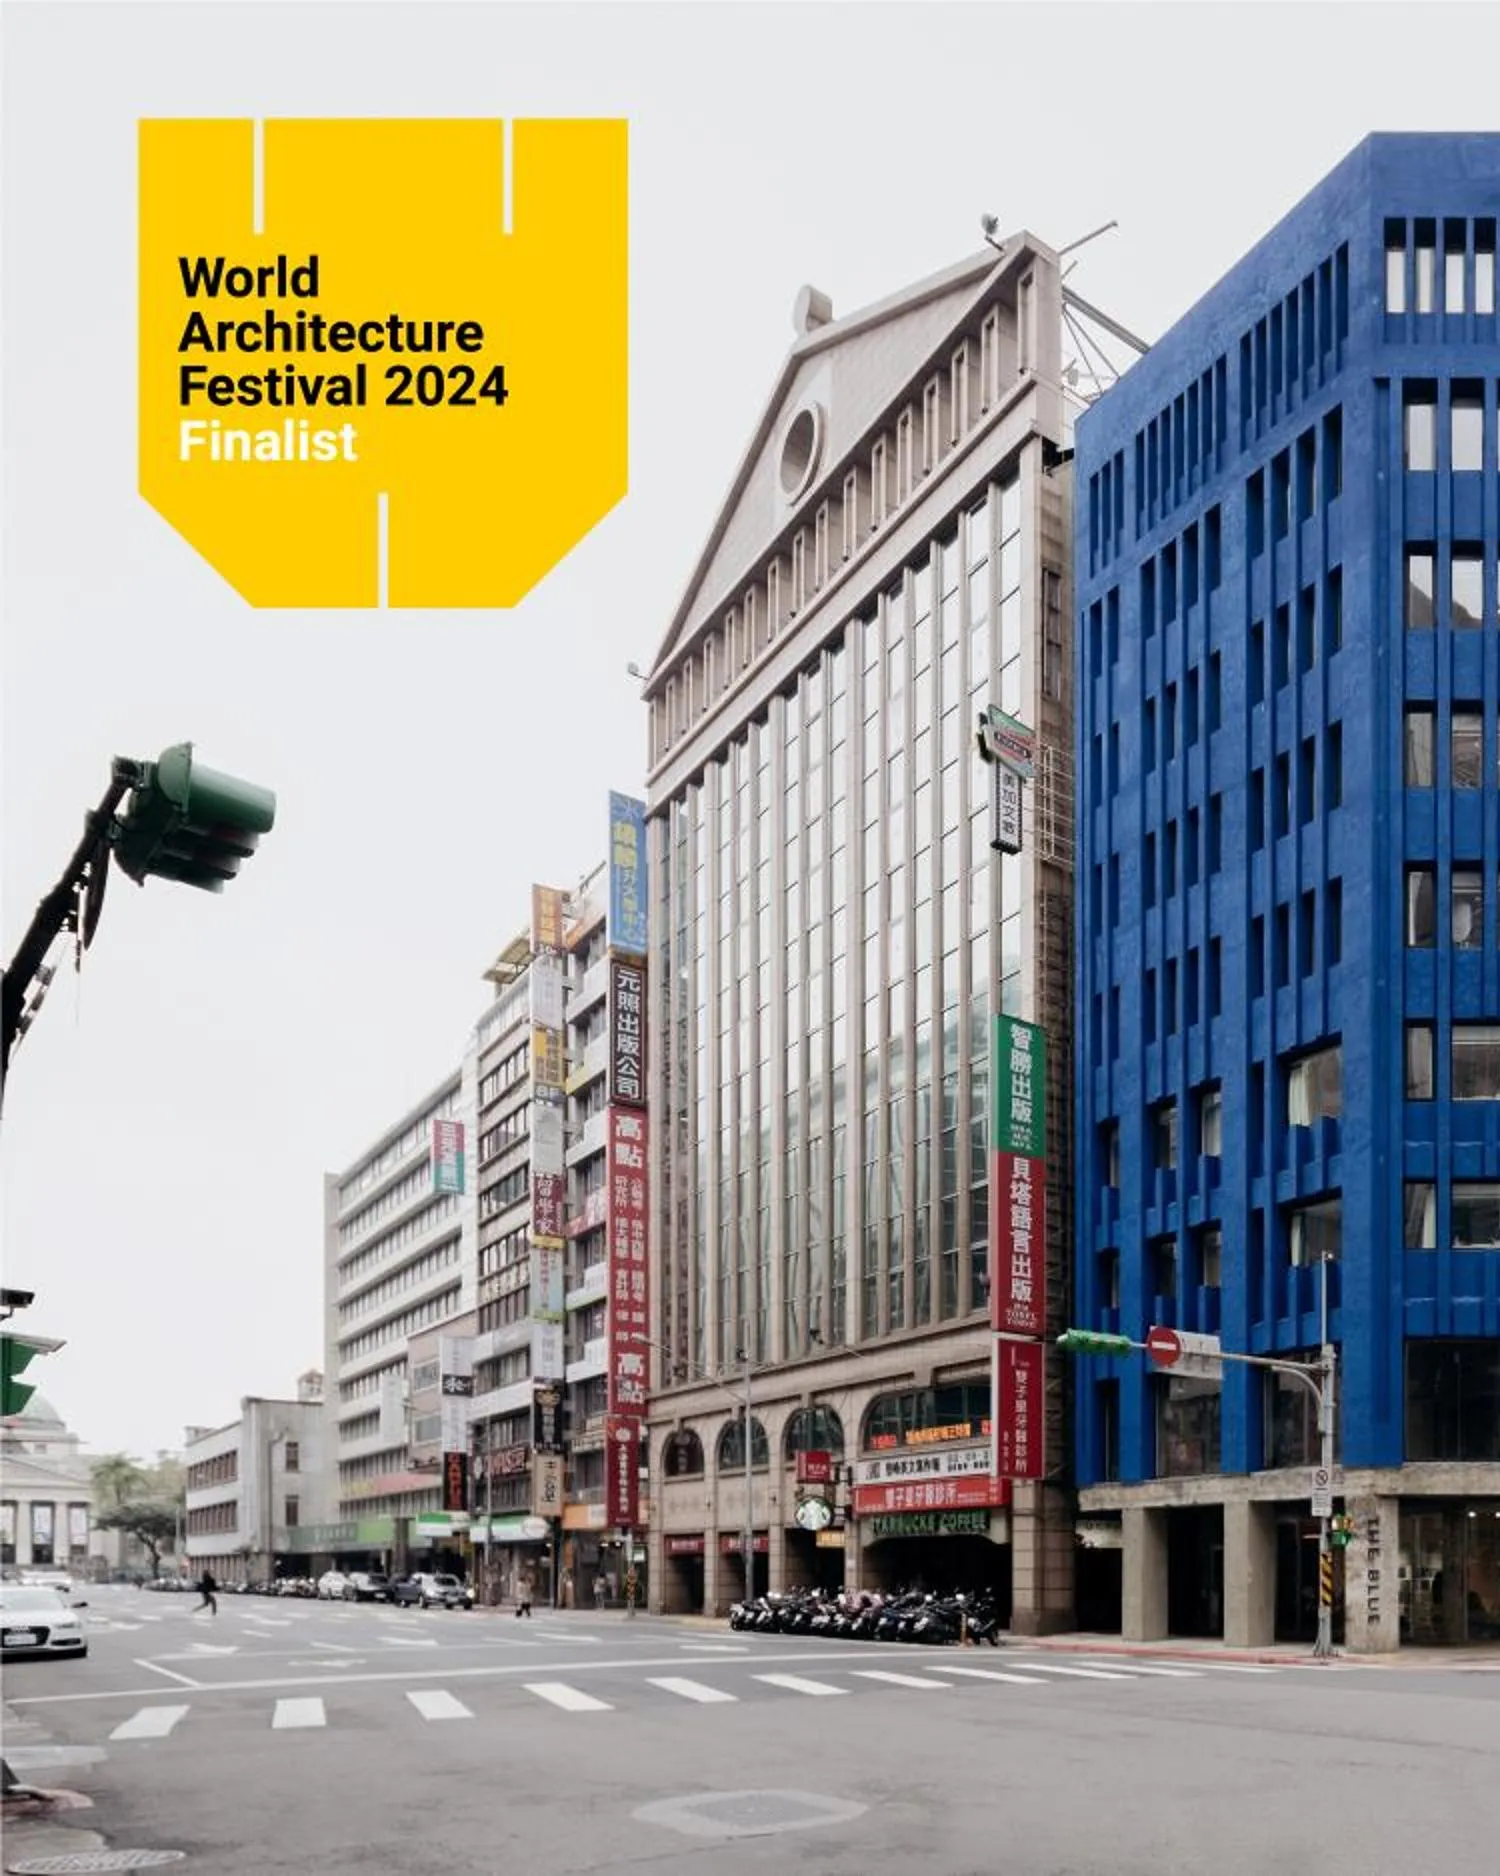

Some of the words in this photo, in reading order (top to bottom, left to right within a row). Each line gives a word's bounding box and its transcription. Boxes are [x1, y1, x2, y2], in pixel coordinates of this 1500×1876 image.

[616, 967, 641, 1098] 元照出版公司
[1010, 1023, 1033, 1123] 智勝出版
[615, 1115, 643, 1169] 高點
[1010, 1156, 1033, 1304] 貝塔語言出版
[616, 1352, 644, 1405] 高點
[1367, 1516, 1381, 1562] THE
[1367, 1569, 1381, 1625] BLUE
